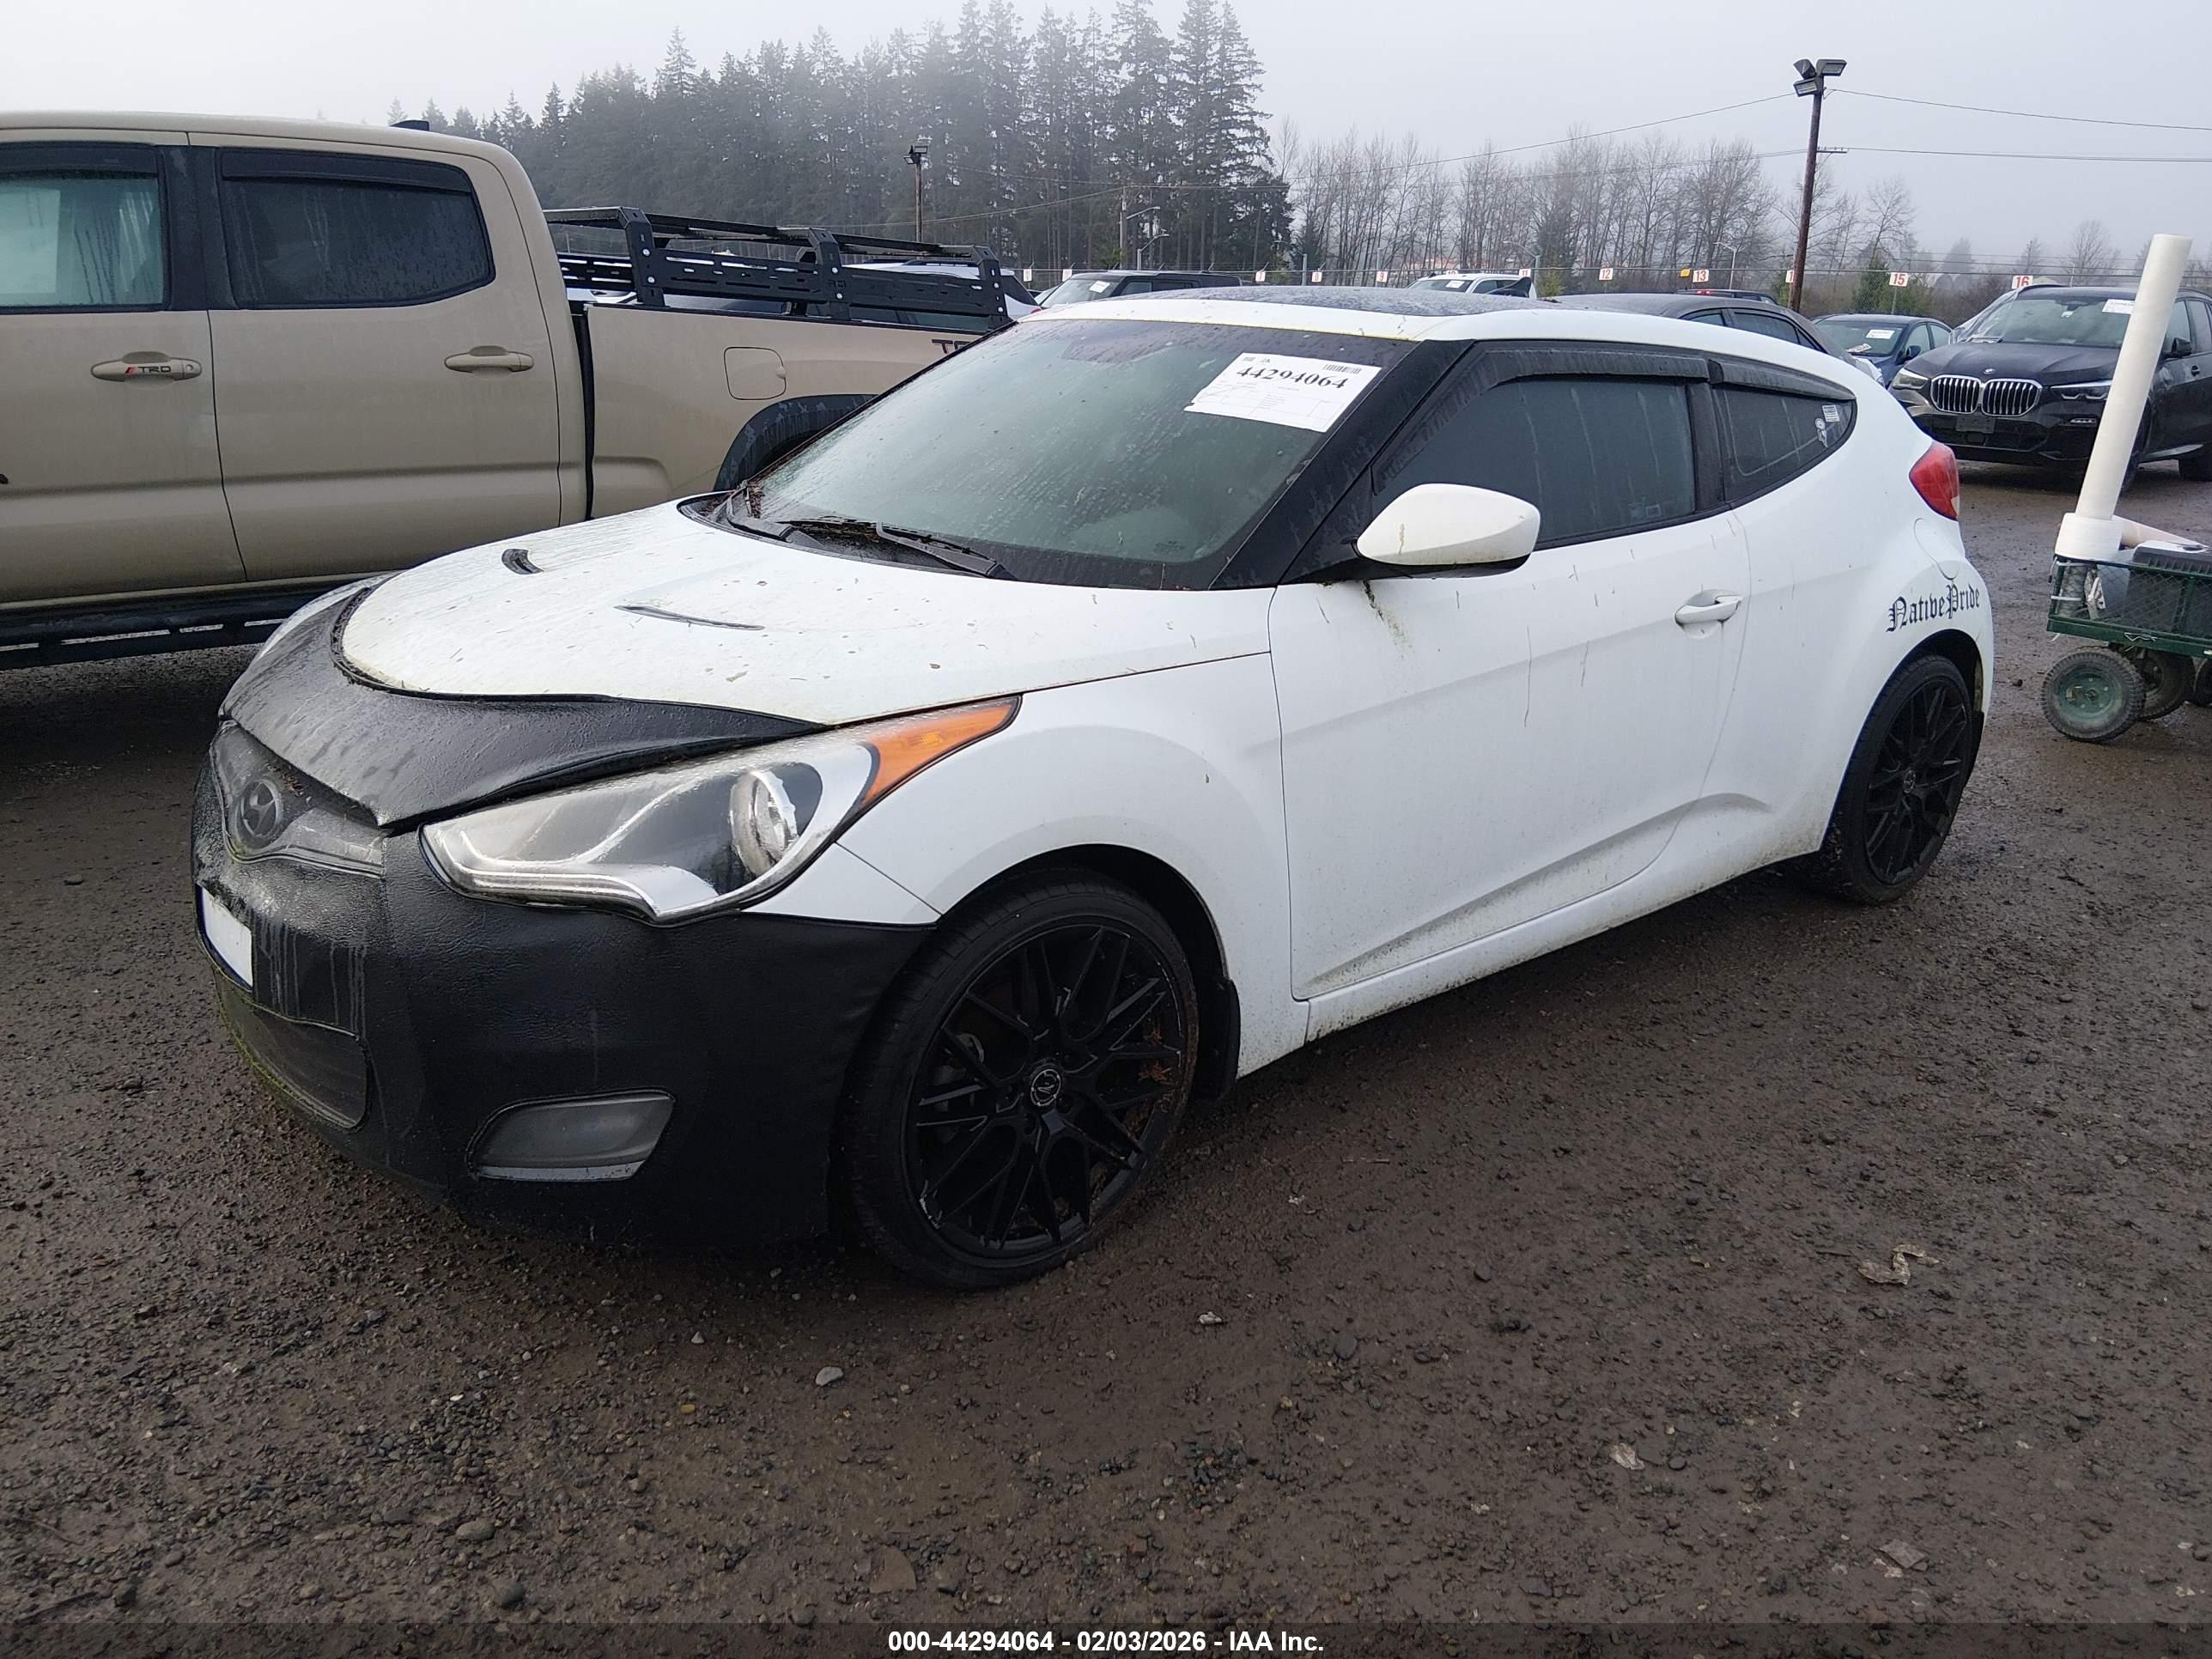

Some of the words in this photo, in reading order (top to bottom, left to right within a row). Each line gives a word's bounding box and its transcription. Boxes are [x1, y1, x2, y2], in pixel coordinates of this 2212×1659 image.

[1601, 270, 1611, 279] 12
[1696, 271, 1707, 281] 13
[1893, 273, 1905, 285] 15
[2016, 276, 2029, 289] 16
[1237, 367, 1350, 389] 44294064
